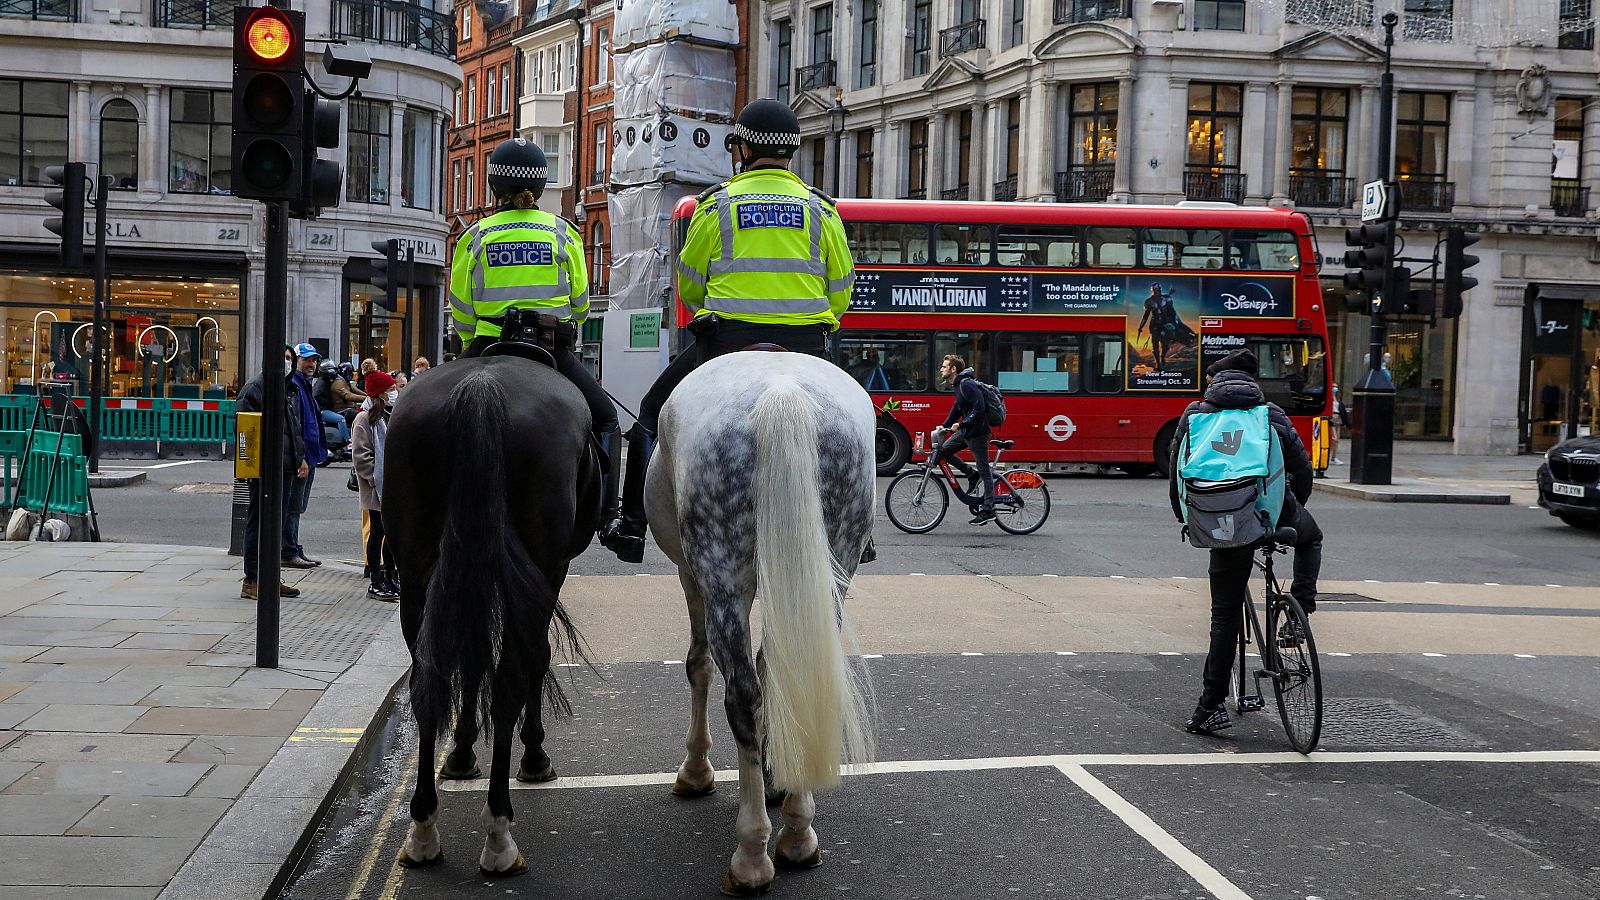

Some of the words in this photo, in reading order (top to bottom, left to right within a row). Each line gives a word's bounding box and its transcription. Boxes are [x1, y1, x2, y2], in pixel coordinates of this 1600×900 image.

[663, 125, 674, 138] R
[697, 131, 708, 145] R
[740, 204, 801, 212] METROPOLITAN
[740, 212, 802, 226] POLICE
[85, 221, 142, 238] URLA
[217, 228, 240, 240] 221
[310, 233, 333, 244] 221
[487, 242, 552, 252] METROPOLITAN
[487, 250, 552, 265] POLICE
[1062, 283, 1111, 292] Mandalorian
[1113, 284, 1120, 292] is
[891, 288, 987, 307] MANDALORIAN
[1062, 292, 1079, 300] cool
[1201, 335, 1246, 346] Metroline
[1137, 378, 1167, 386] Streaming
